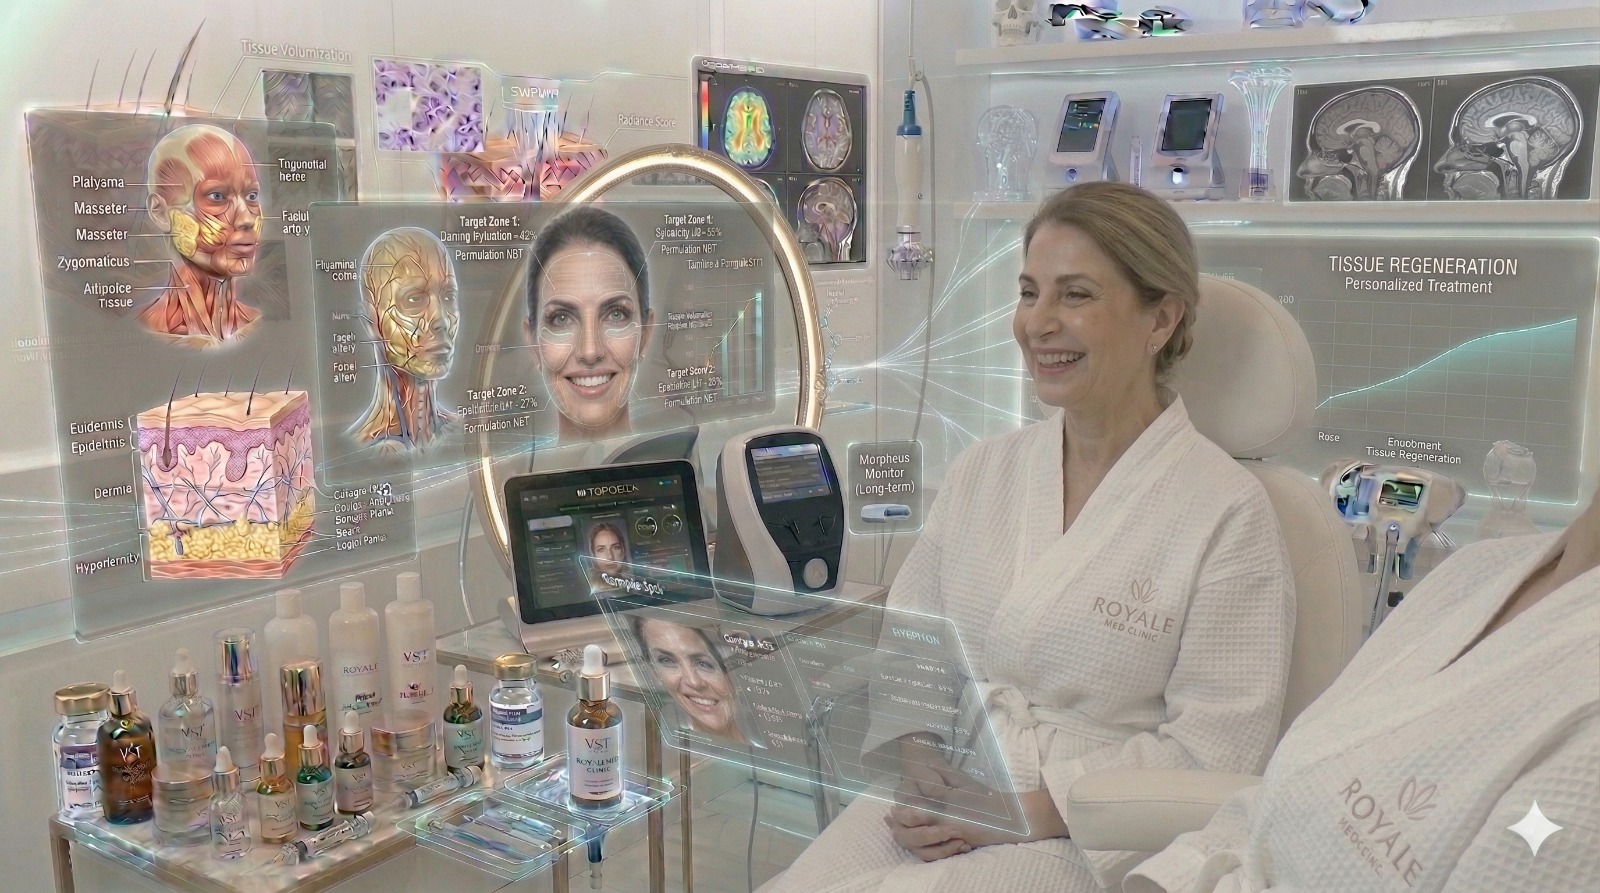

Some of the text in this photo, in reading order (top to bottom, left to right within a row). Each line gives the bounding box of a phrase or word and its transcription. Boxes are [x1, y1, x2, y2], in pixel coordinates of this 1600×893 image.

[241, 39, 352, 62] Tissue Volumization
[618, 113, 677, 128] Radiance Score
[74, 201, 128, 215] Masseter
[460, 215, 487, 229] Target
[488, 215, 510, 227] Zone
[664, 214, 687, 226] Target
[688, 214, 705, 225] Zone
[76, 228, 128, 241] Masseter
[455, 248, 524, 261] Permulation NBT
[1328, 255, 1518, 276] TISSUE REGENERATION
[1345, 276, 1493, 294] Personalized Treatment
[98, 297, 134, 309] Tissue
[667, 367, 689, 379] Target
[466, 384, 527, 401] Target Zone 2:
[520, 397, 538, 410] 27%
[463, 419, 512, 435] Formulation
[1318, 431, 1340, 442] Rose
[859, 453, 910, 467] Morpheus
[1366, 446, 1462, 464] Tissue Regeneration
[865, 467, 905, 480] Monitor
[855, 480, 915, 497] (Long-term)
[1092, 596, 1175, 634] ROYALE
[1104, 618, 1158, 643] MED CLINIC
[343, 662, 379, 674] ROYALE
[584, 736, 611, 750] VST
[1338, 777, 1424, 888] ROYALE
